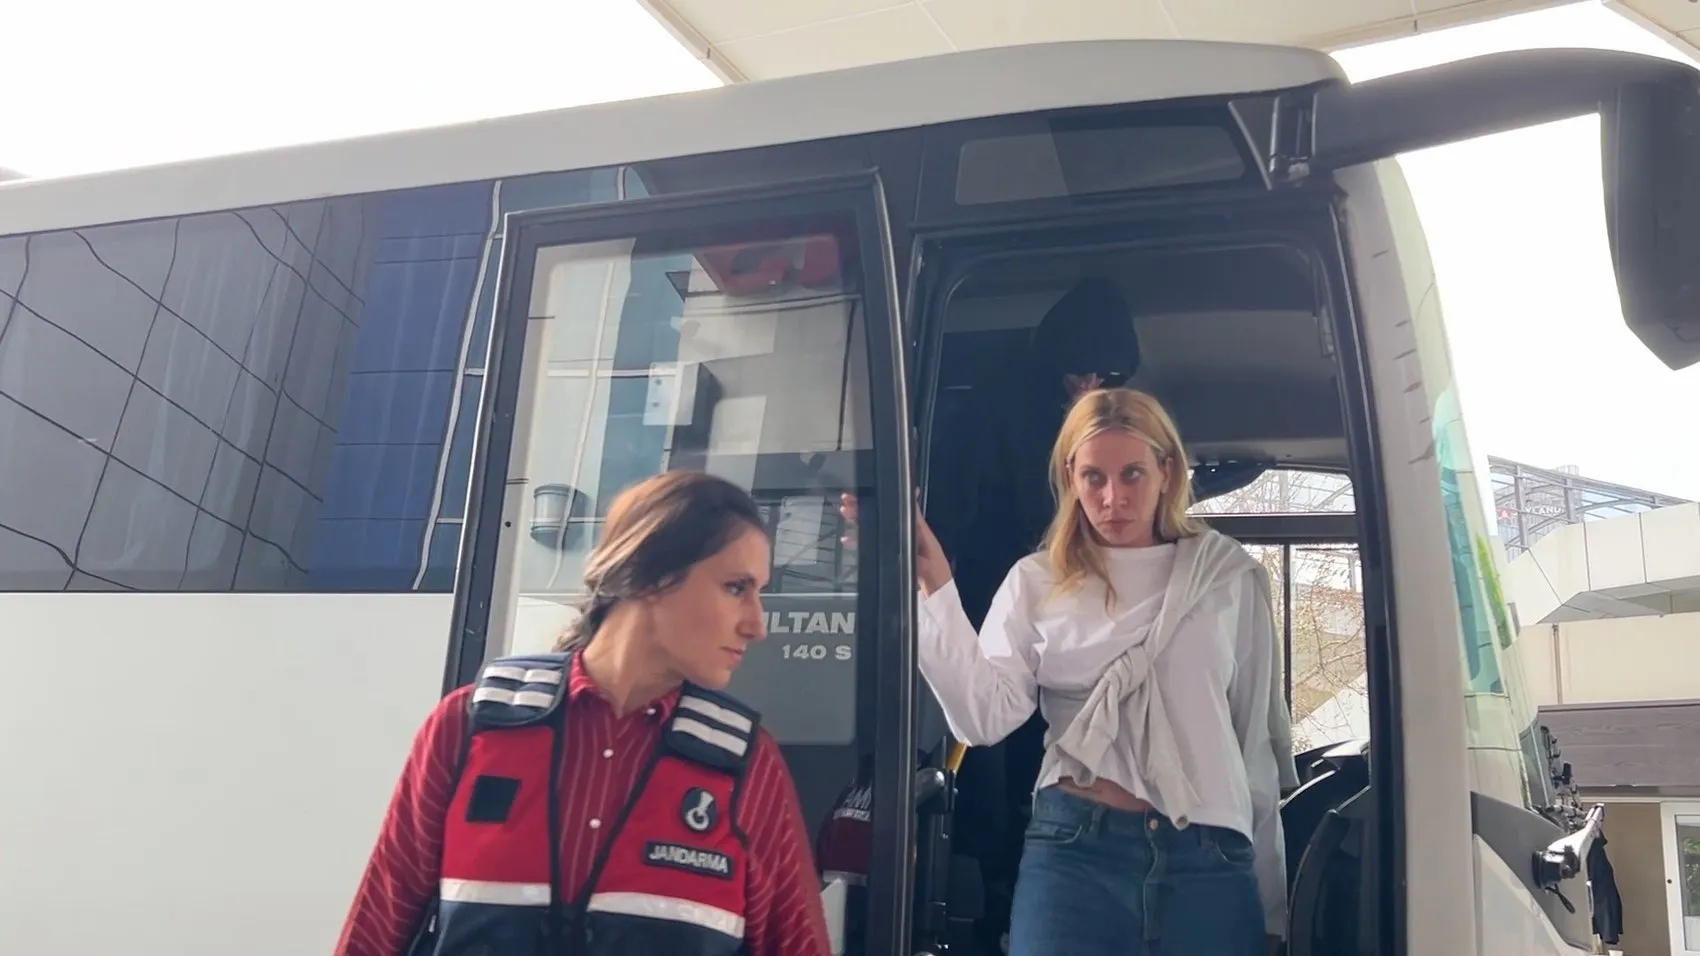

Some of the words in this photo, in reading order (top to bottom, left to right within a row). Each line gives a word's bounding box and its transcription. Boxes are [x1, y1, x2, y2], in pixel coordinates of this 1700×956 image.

[782, 644, 827, 660] 140
[835, 645, 852, 660] S
[649, 845, 729, 873] JANDARMA
